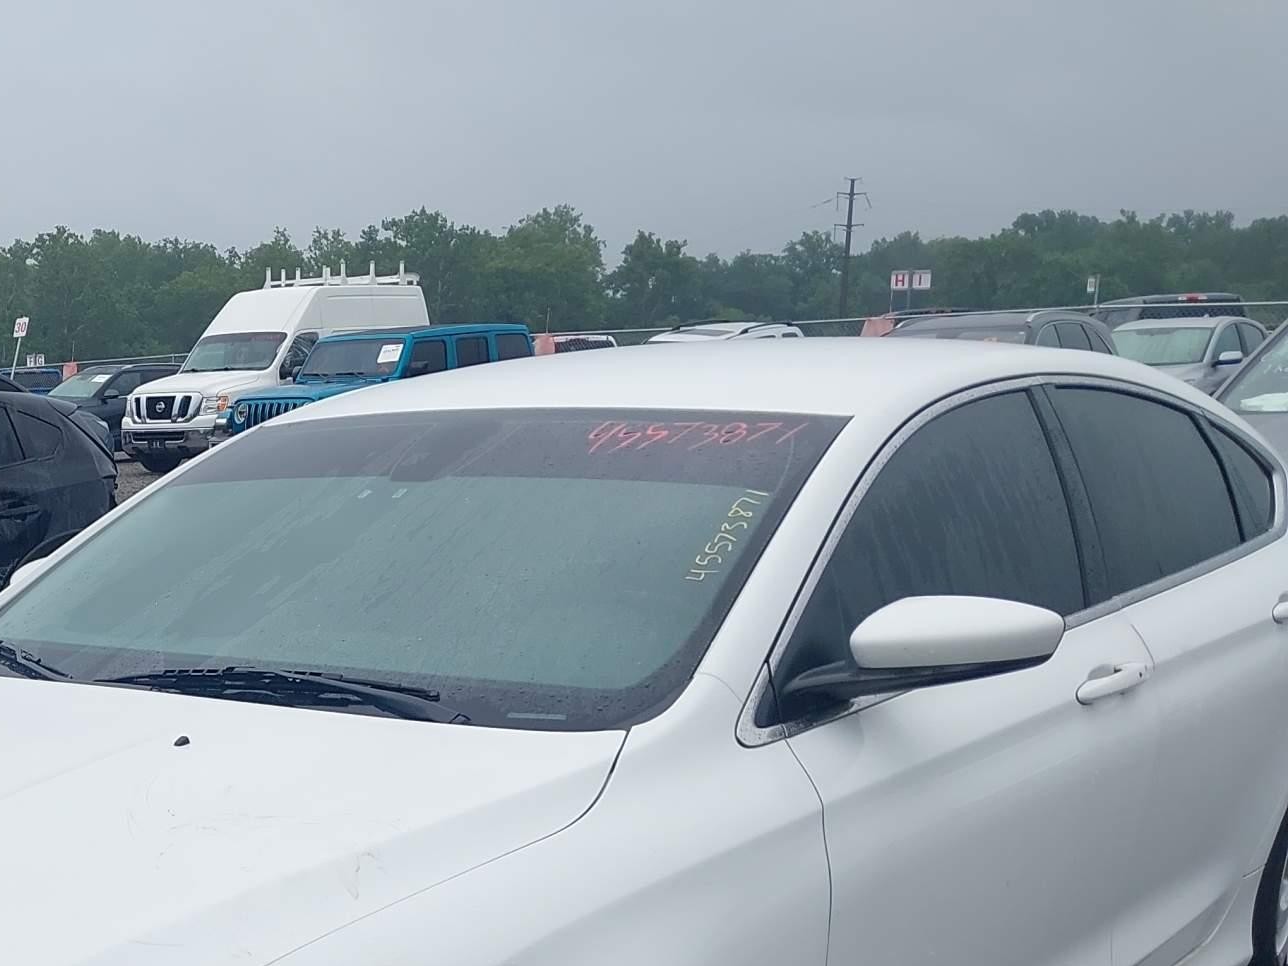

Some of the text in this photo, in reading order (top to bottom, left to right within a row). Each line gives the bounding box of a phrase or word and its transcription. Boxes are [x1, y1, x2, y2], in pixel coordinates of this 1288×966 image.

[895, 273, 905, 287] H
[15, 321, 27, 334] 30
[588, 420, 808, 455] 45573871
[684, 488, 770, 582] 45573871
